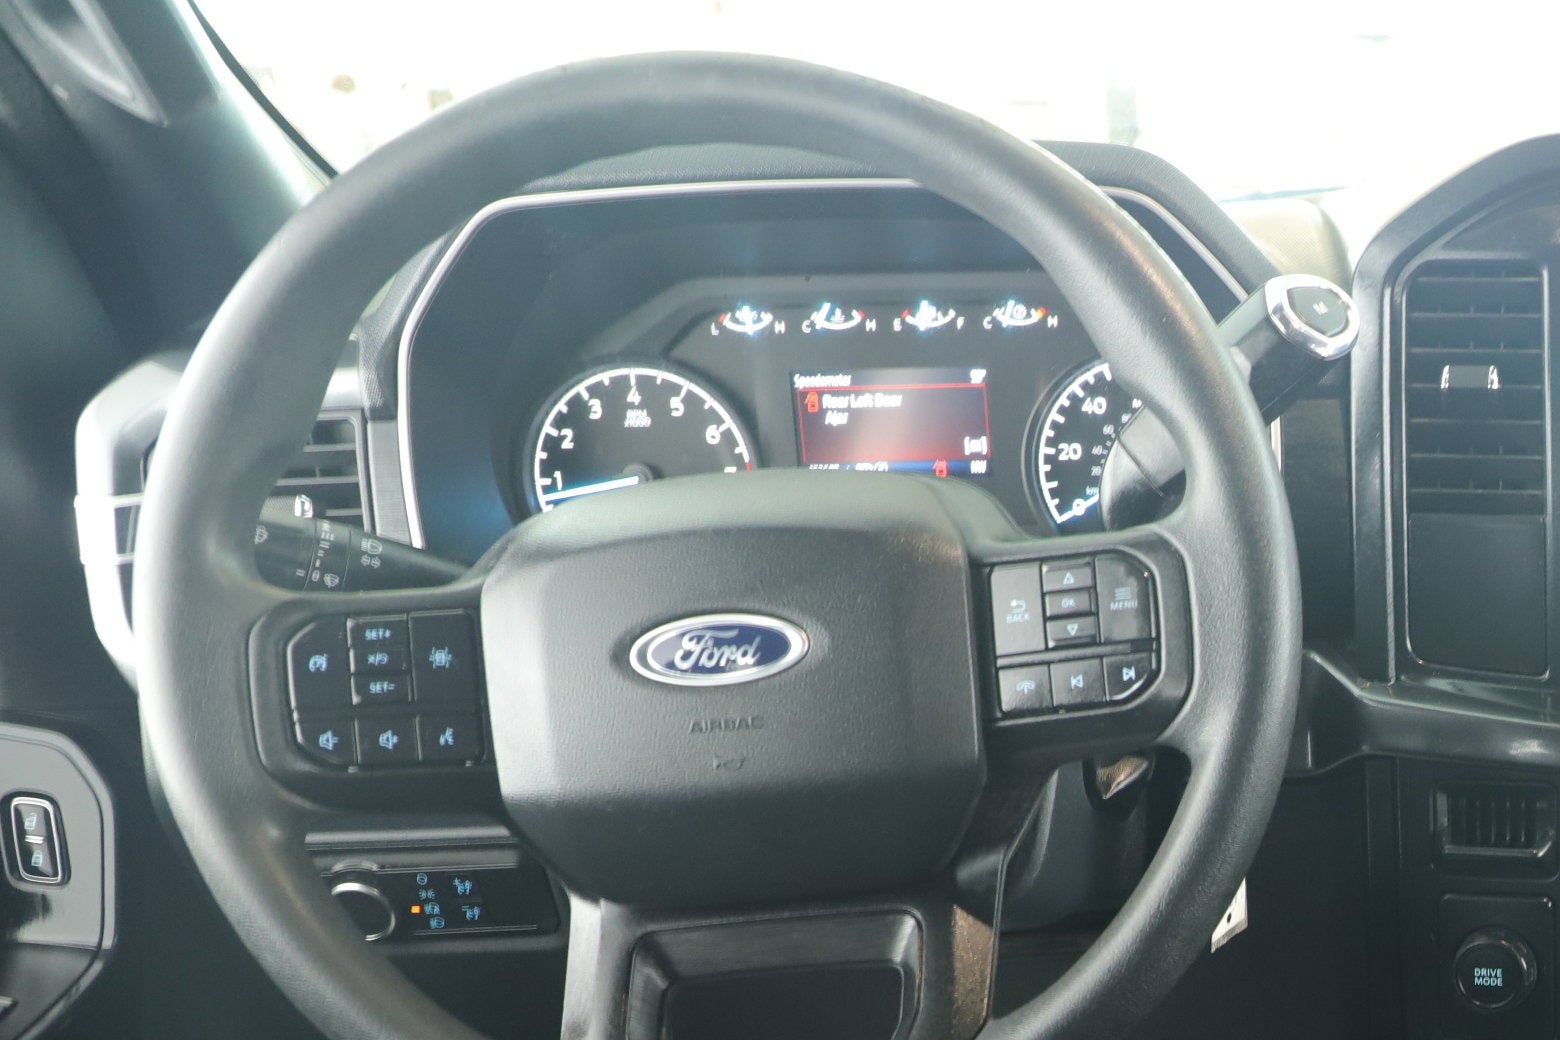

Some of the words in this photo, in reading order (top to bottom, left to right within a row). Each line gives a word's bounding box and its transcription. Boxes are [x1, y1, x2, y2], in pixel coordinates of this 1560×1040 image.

[626, 385, 641, 405] 4
[588, 398, 602, 419] 3
[670, 397, 684, 417] 5
[1081, 397, 1107, 414] 40
[560, 429, 574, 449] 2
[705, 425, 720, 445] 6
[1058, 443, 1082, 460] 20
[554, 471, 563, 490] 1
[1110, 600, 1138, 611] MENU
[1006, 613, 1030, 624] BACK
[674, 628, 762, 670] Ford
[1474, 967, 1502, 977] DRIVE
[1474, 977, 1503, 986] MODE
